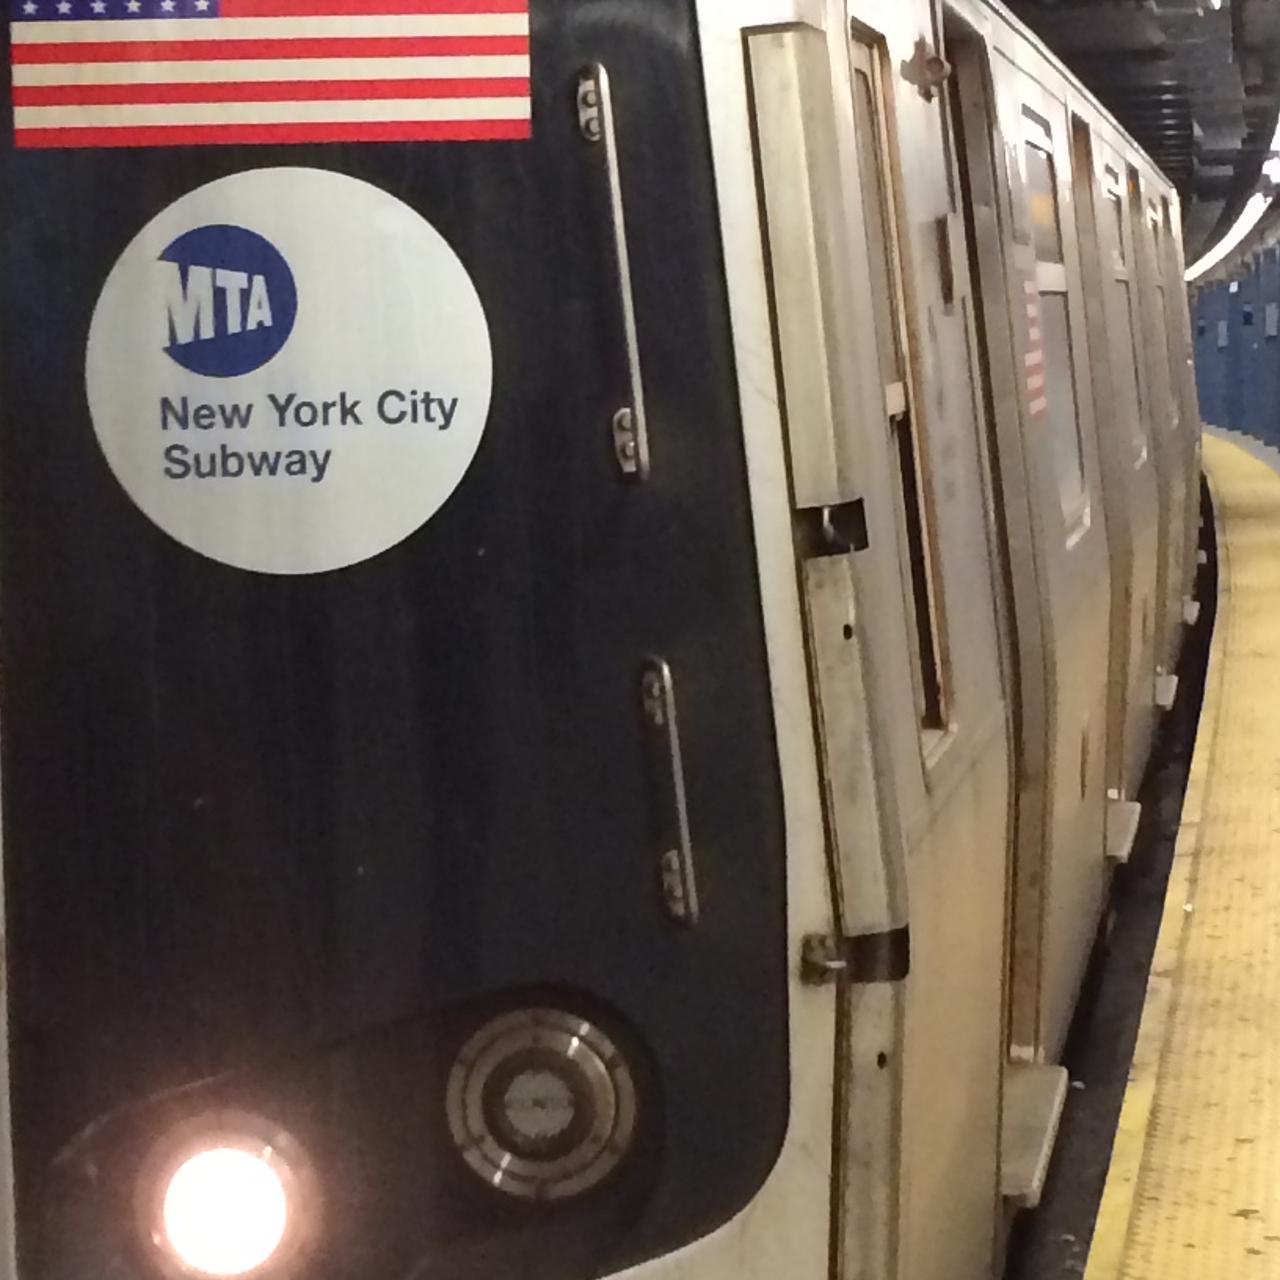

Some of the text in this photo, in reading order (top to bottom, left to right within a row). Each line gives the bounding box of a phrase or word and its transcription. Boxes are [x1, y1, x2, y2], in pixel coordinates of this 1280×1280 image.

[158, 258, 273, 345] MTA
[160, 388, 459, 431] New York City
[163, 443, 332, 483] Subway
